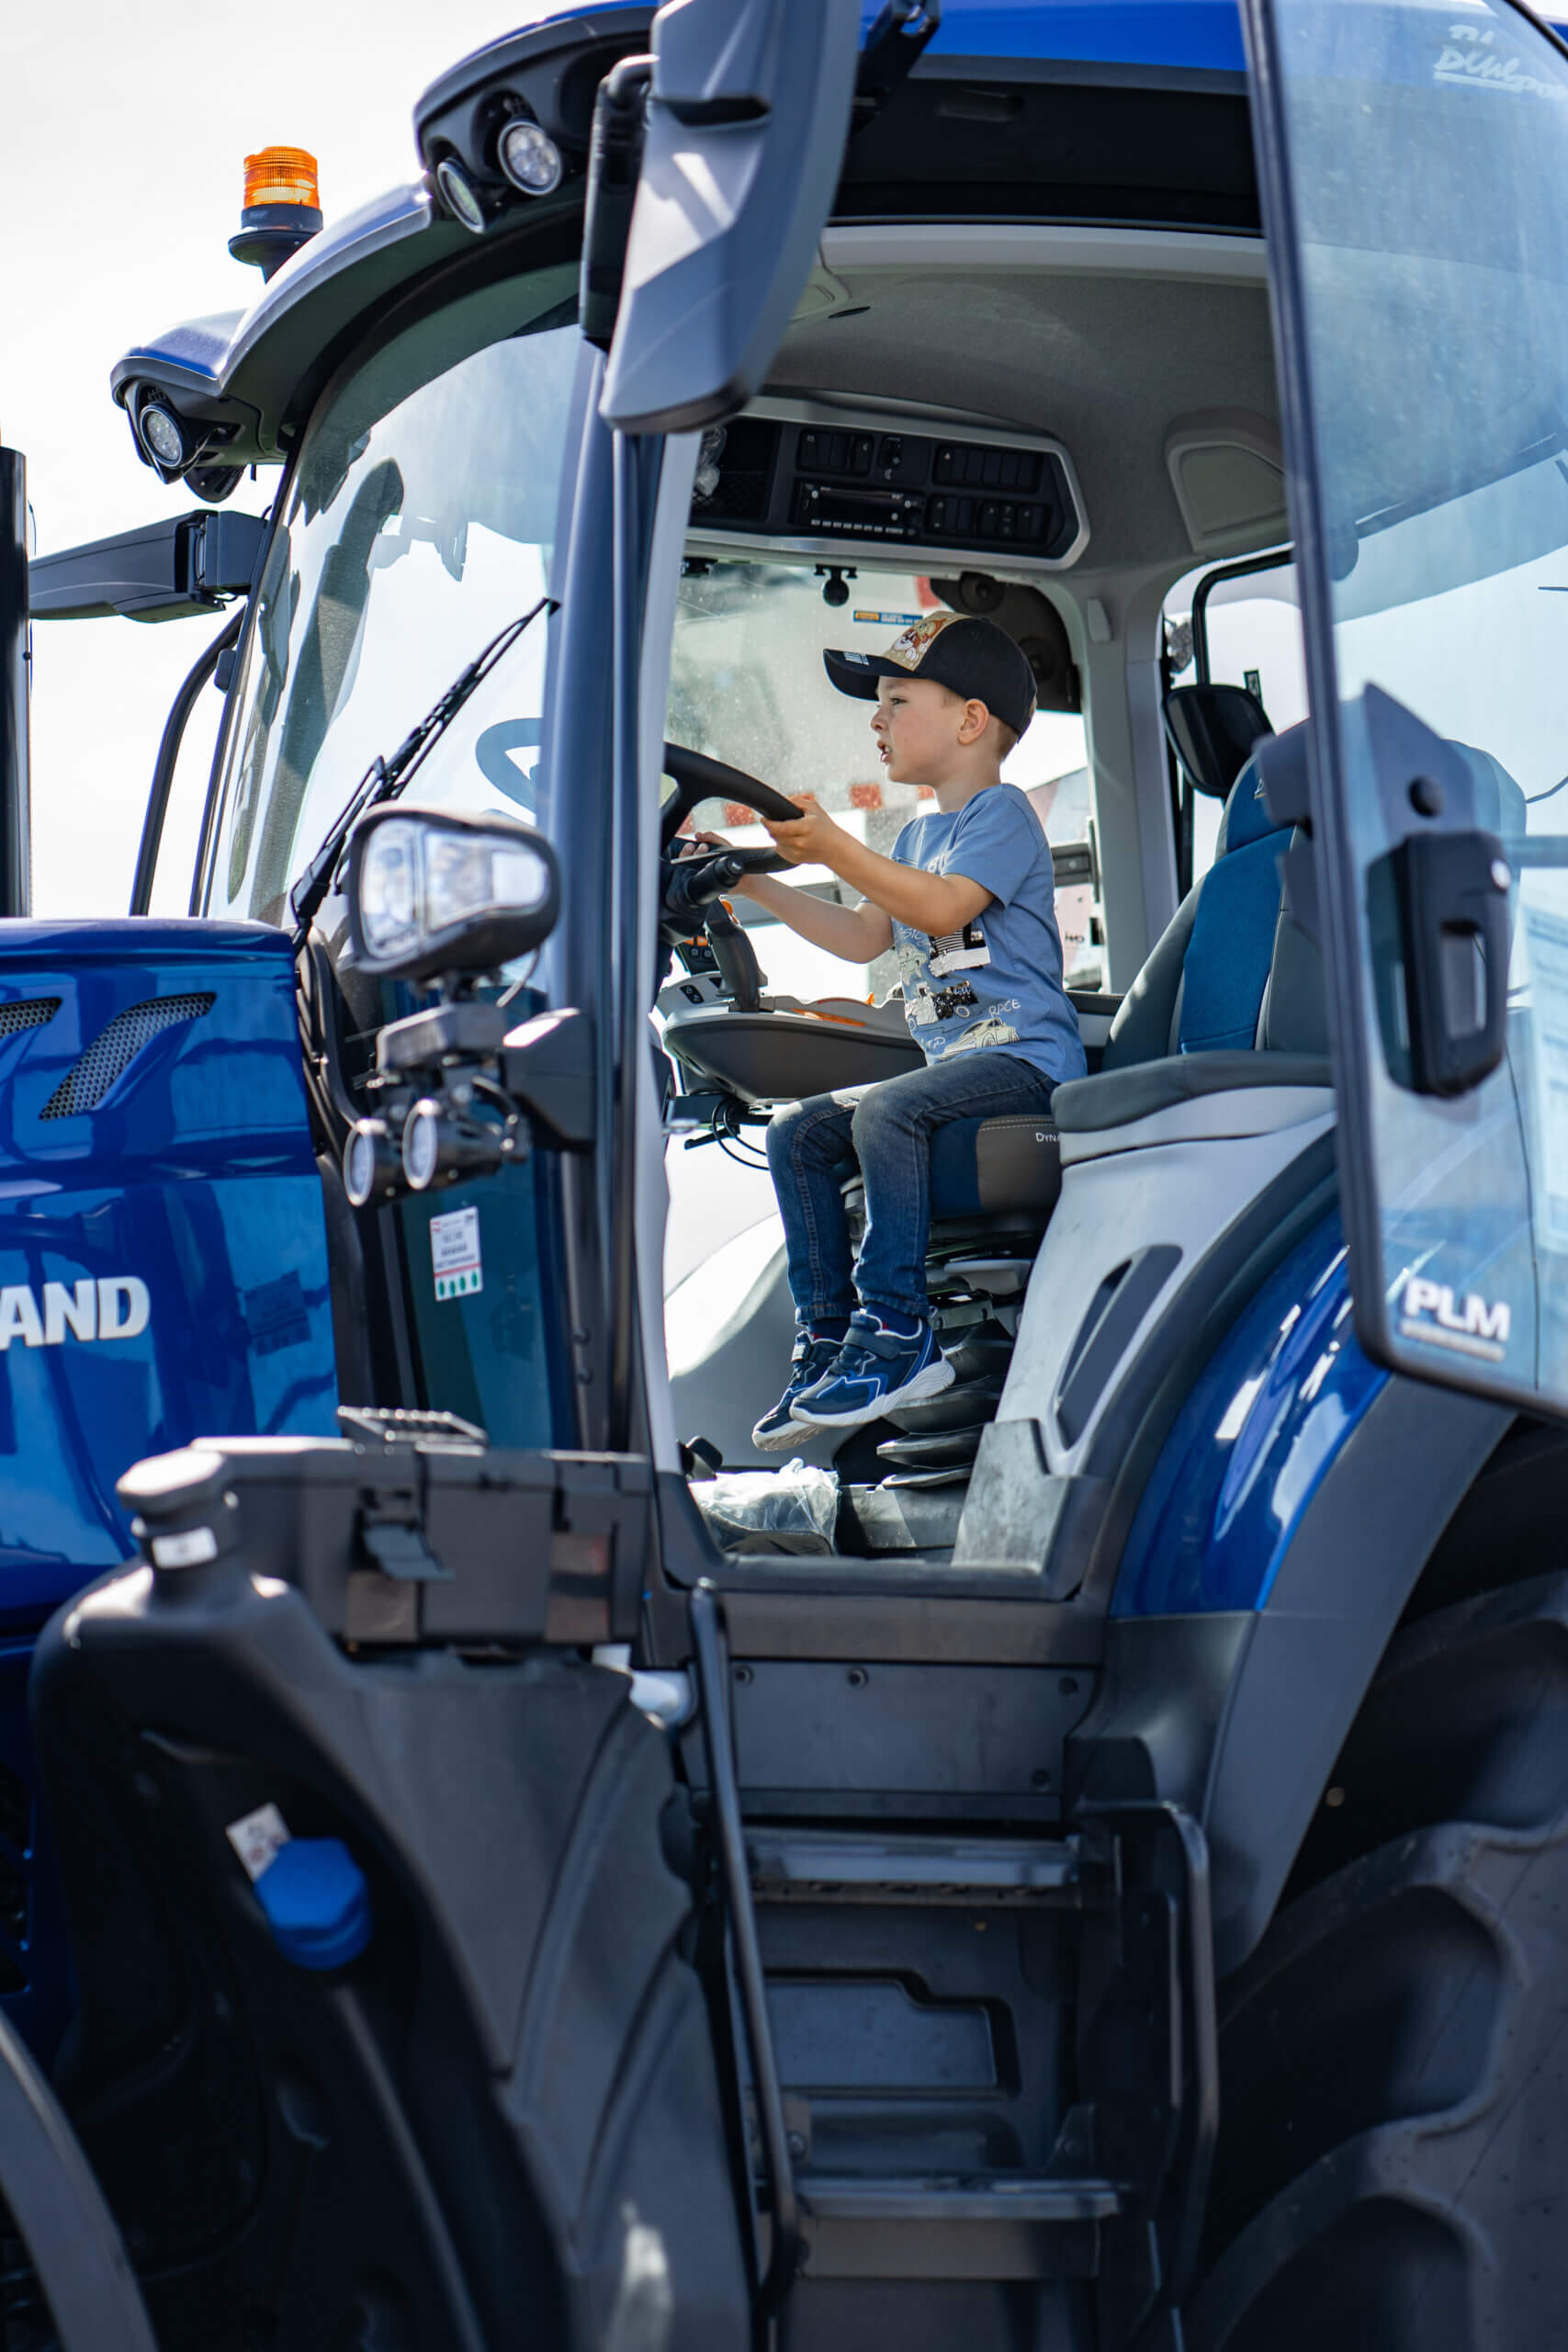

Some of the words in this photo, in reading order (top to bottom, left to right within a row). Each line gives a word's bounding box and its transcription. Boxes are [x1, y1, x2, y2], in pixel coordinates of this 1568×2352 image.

[988, 999, 1021, 1018] RACE
[0, 1275, 151, 1351] AND
[1404, 1278, 1511, 1342] PLM
